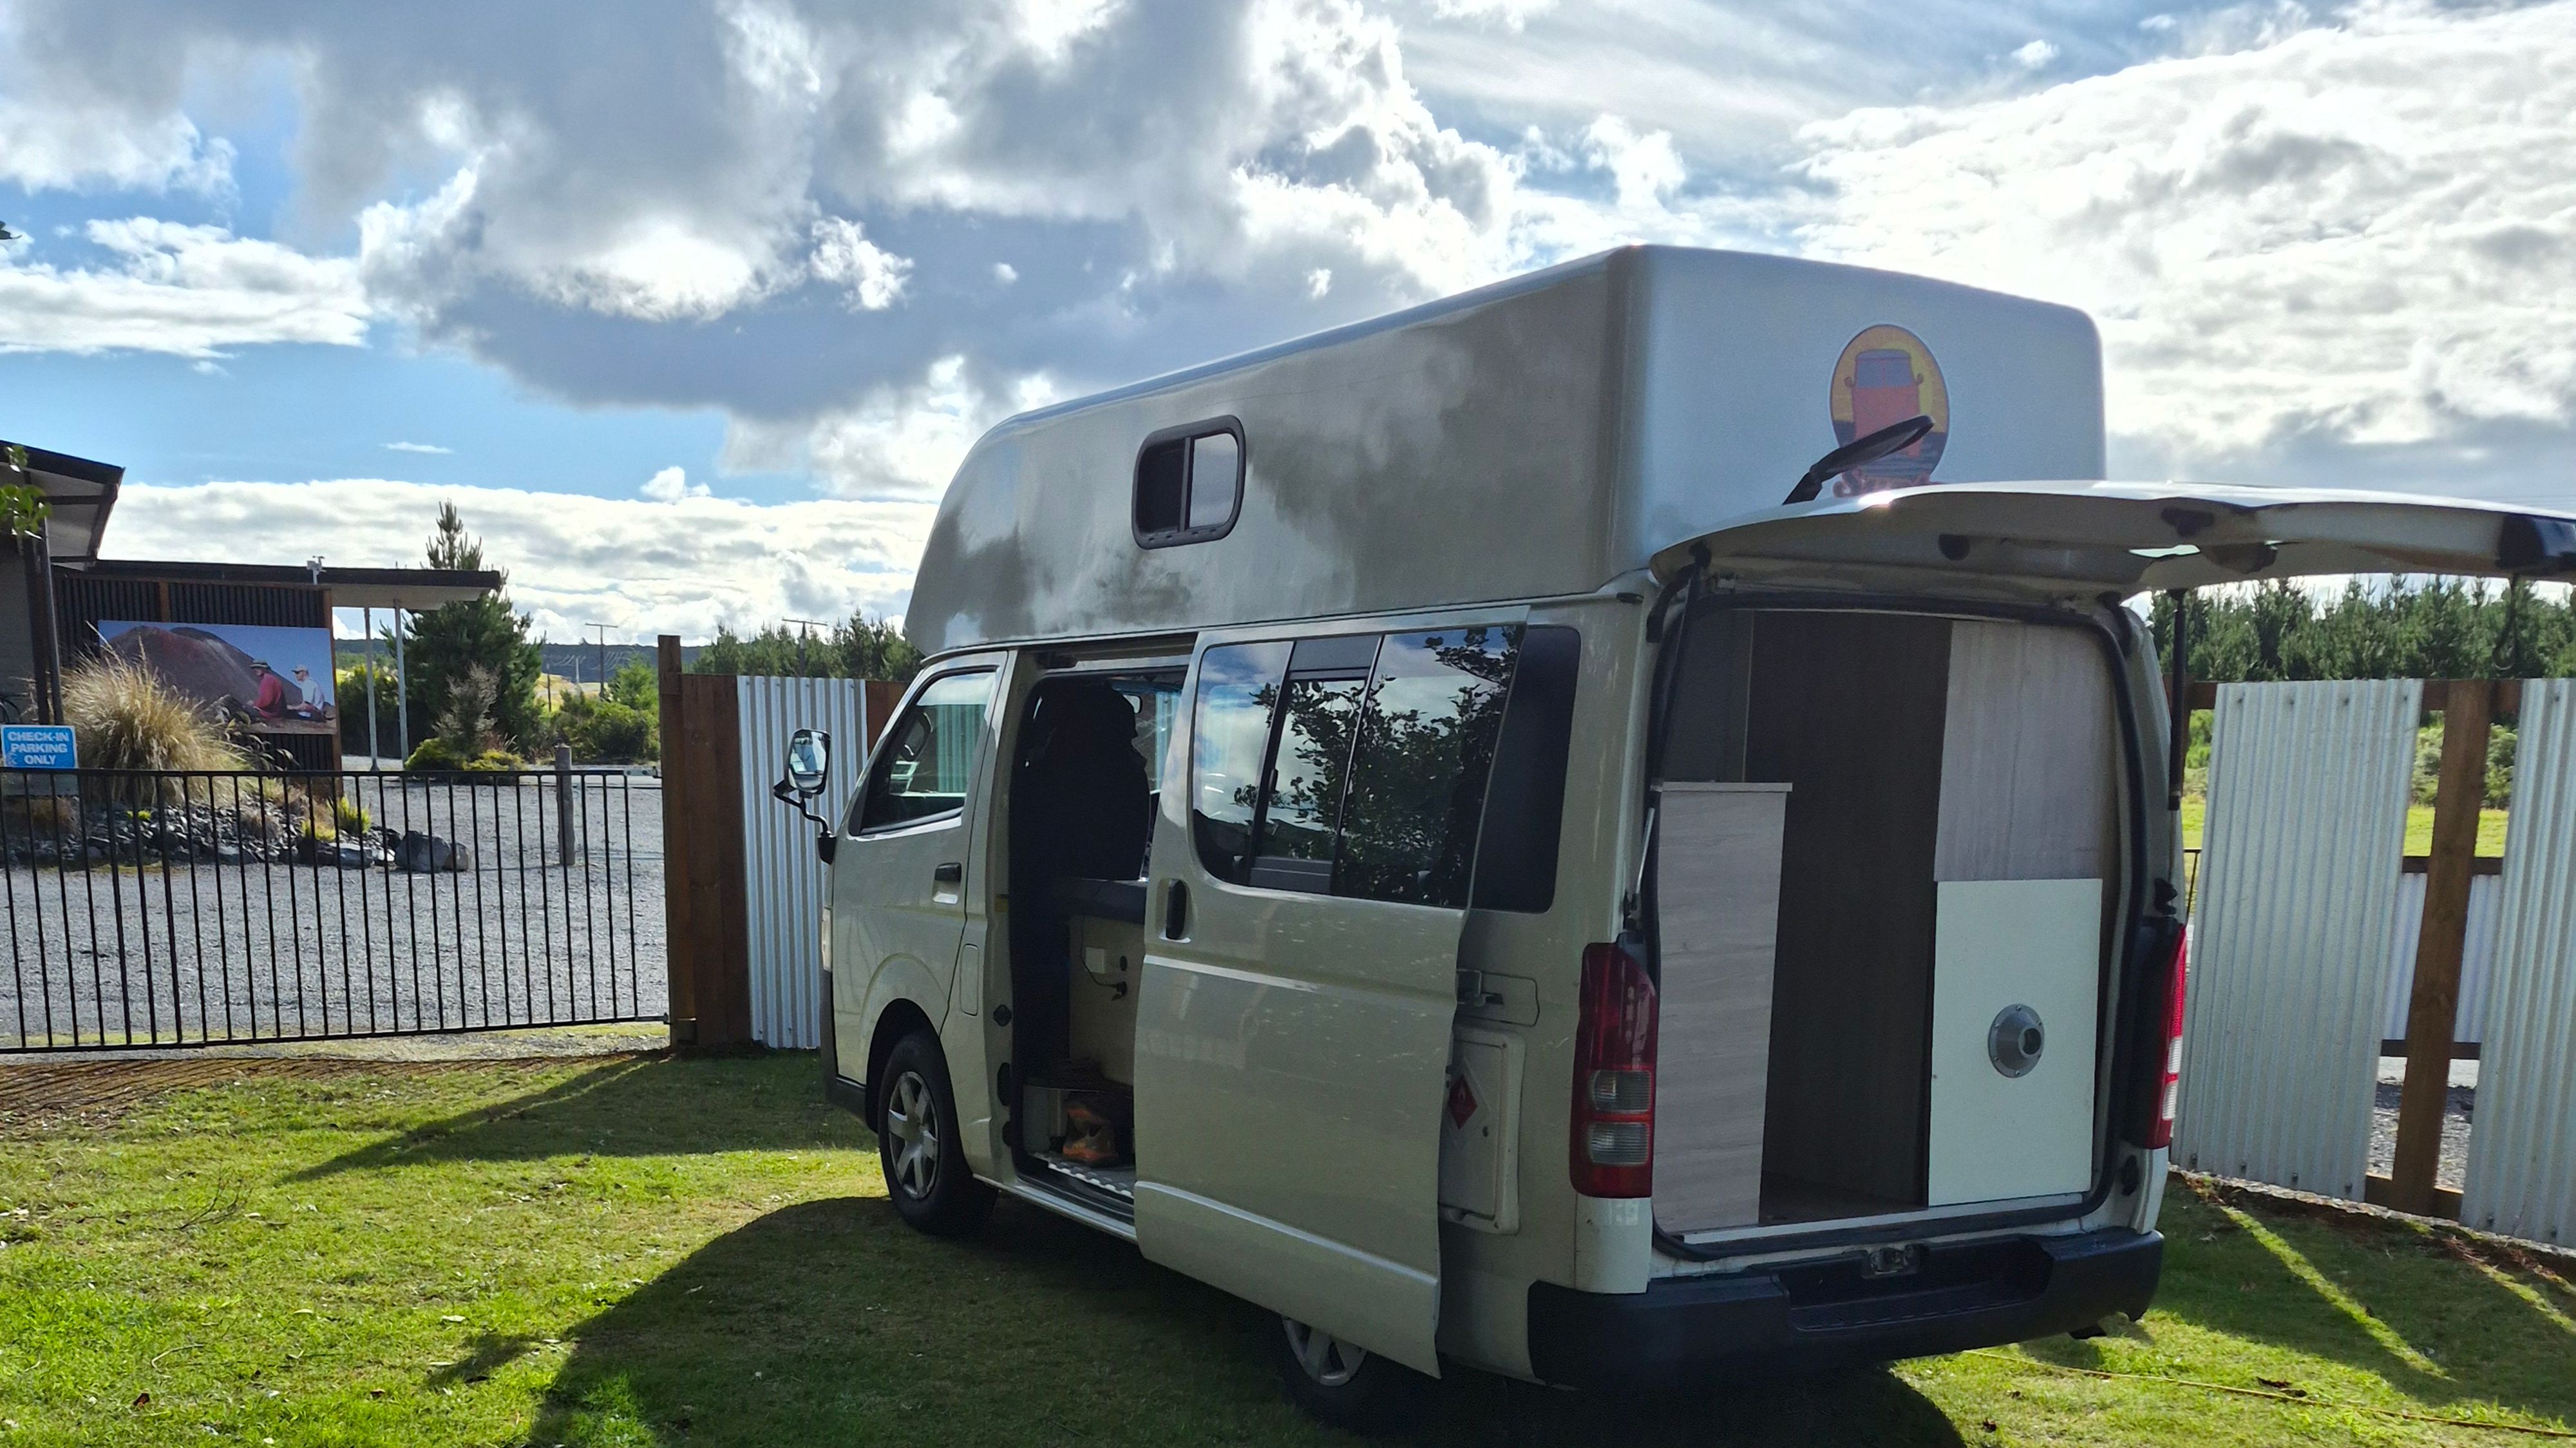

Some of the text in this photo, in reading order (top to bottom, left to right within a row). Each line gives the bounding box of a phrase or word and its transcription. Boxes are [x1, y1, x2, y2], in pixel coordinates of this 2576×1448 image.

[8, 731, 69, 741] CHECK-IN
[10, 743, 68, 753] PARKING
[24, 754, 56, 765] ONLY
